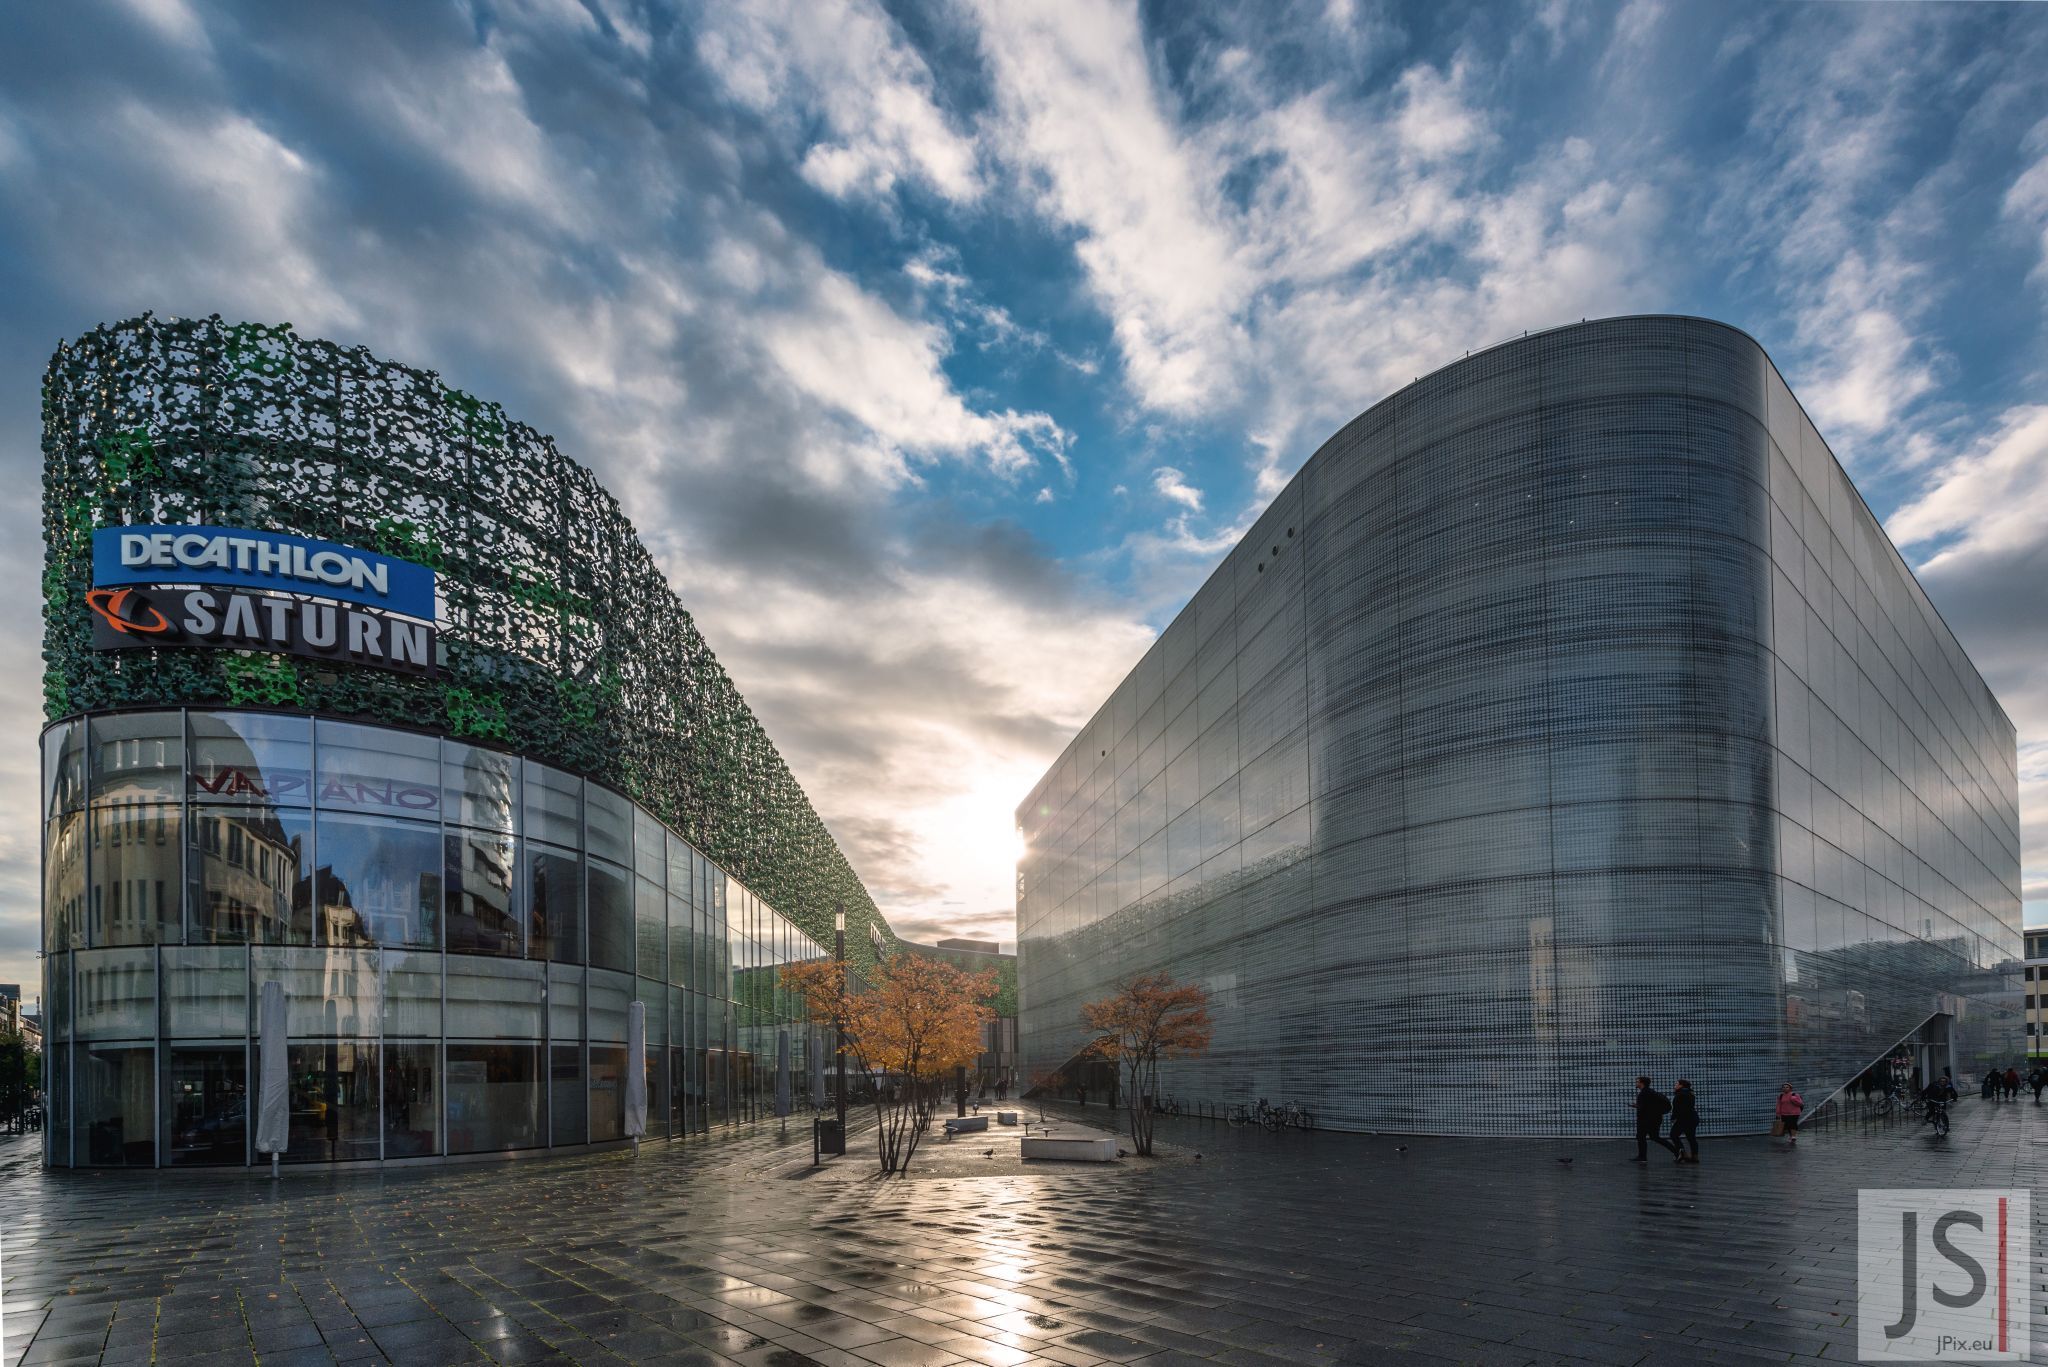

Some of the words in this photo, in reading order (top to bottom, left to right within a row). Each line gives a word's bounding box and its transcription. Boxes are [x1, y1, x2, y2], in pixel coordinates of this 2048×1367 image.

[121, 534, 389, 596] DECATHLON
[183, 591, 429, 668] SATURN
[194, 766, 439, 810] VAPIANO
